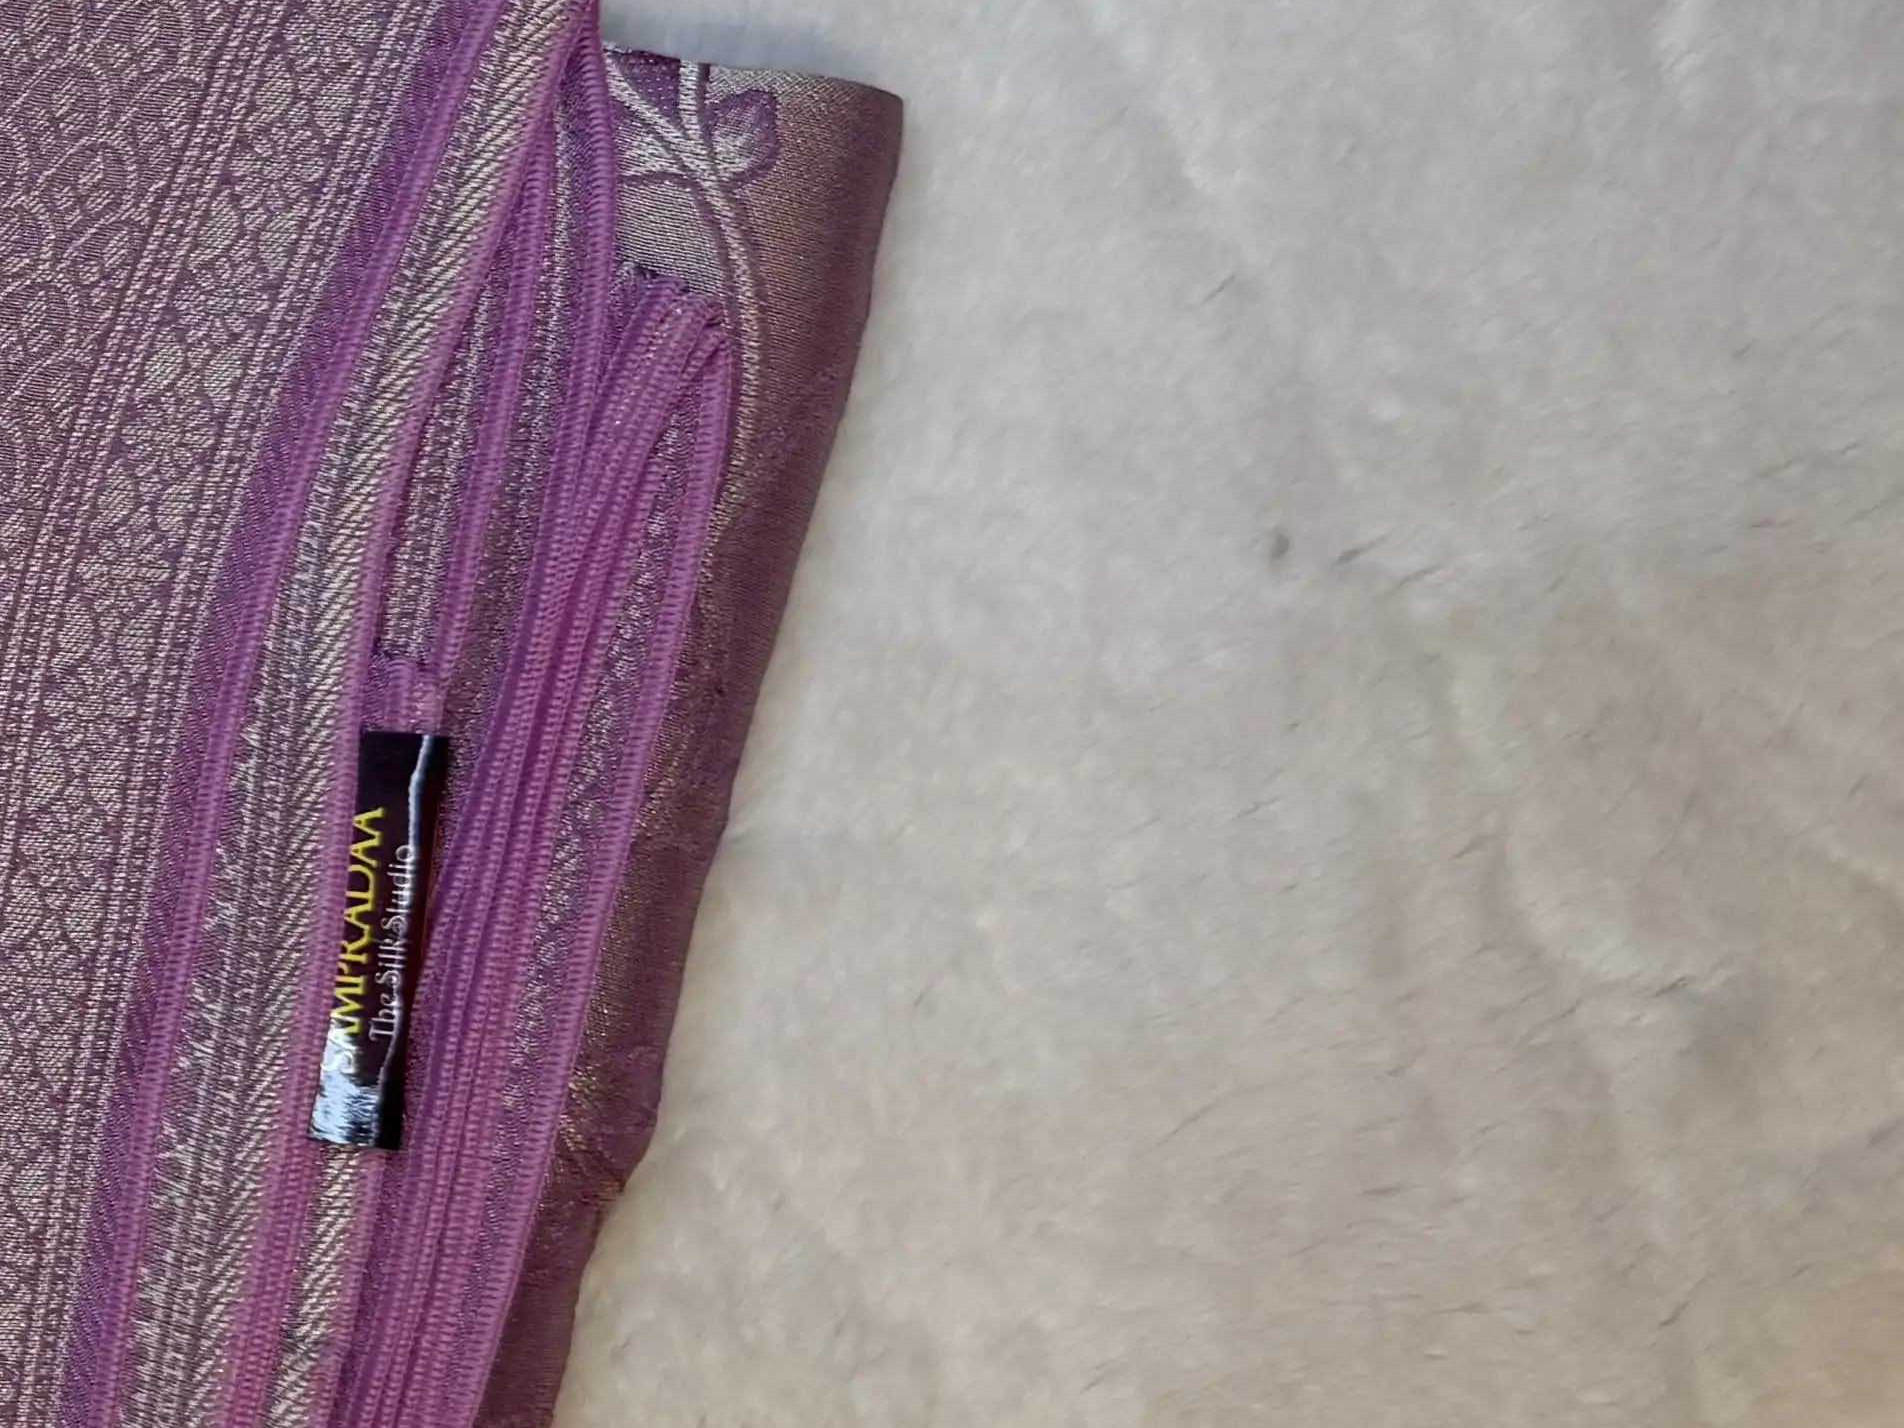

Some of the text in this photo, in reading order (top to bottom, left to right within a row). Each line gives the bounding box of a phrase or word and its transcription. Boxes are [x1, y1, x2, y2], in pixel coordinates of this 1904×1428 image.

[368, 843, 413, 1042] The Silk Studio
